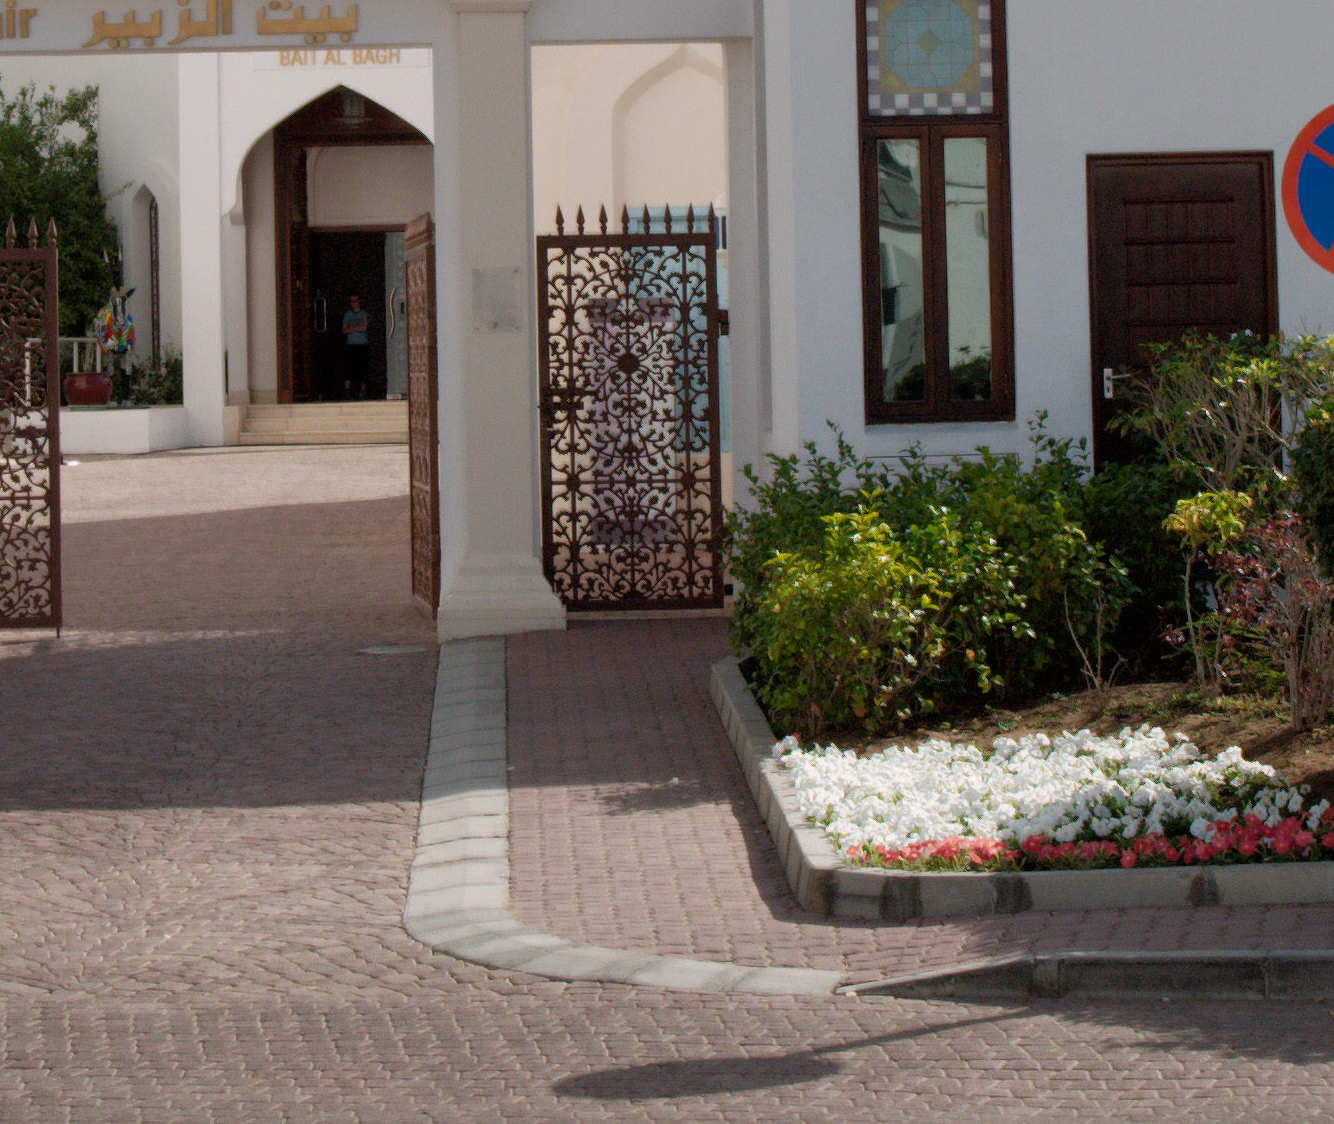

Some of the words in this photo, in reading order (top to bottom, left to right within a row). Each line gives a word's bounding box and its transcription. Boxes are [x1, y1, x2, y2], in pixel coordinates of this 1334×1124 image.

[257, 4, 357, 44] بيت
[279, 50, 316, 66] BAIT
[323, 48, 347, 65] AL
[352, 48, 400, 65] BAGH
